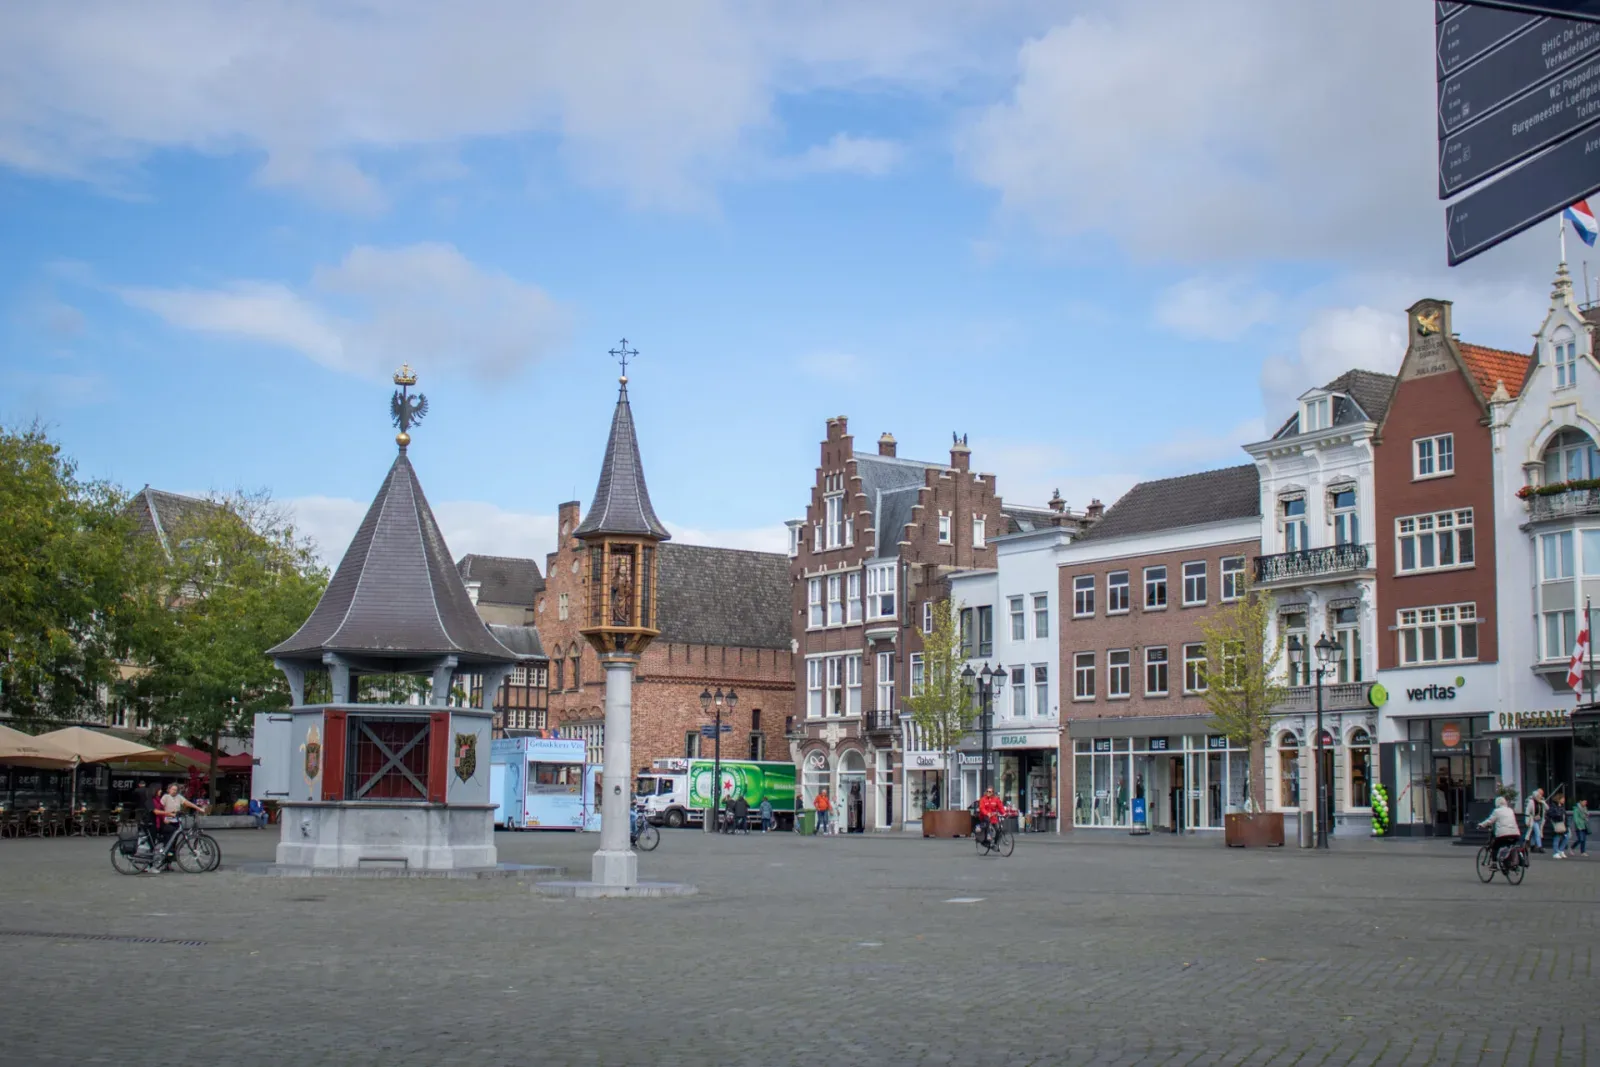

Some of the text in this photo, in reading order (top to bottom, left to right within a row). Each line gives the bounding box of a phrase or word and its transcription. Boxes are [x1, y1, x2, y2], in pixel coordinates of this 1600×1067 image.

[1541, 35, 1562, 56] BHIC
[1563, 29, 1574, 42] De
[1549, 63, 1600, 99] W2 Poppodiu
[1511, 101, 1564, 136] Burgemeester
[1585, 136, 1600, 155] Are
[1406, 684, 1456, 701] veritas
[529, 741, 570, 749] Gebakken
[1001, 736, 1027, 745] DOUGLAS
[1151, 739, 1166, 749] WE
[1210, 737, 1226, 748] WE
[916, 756, 936, 766] Gabor
